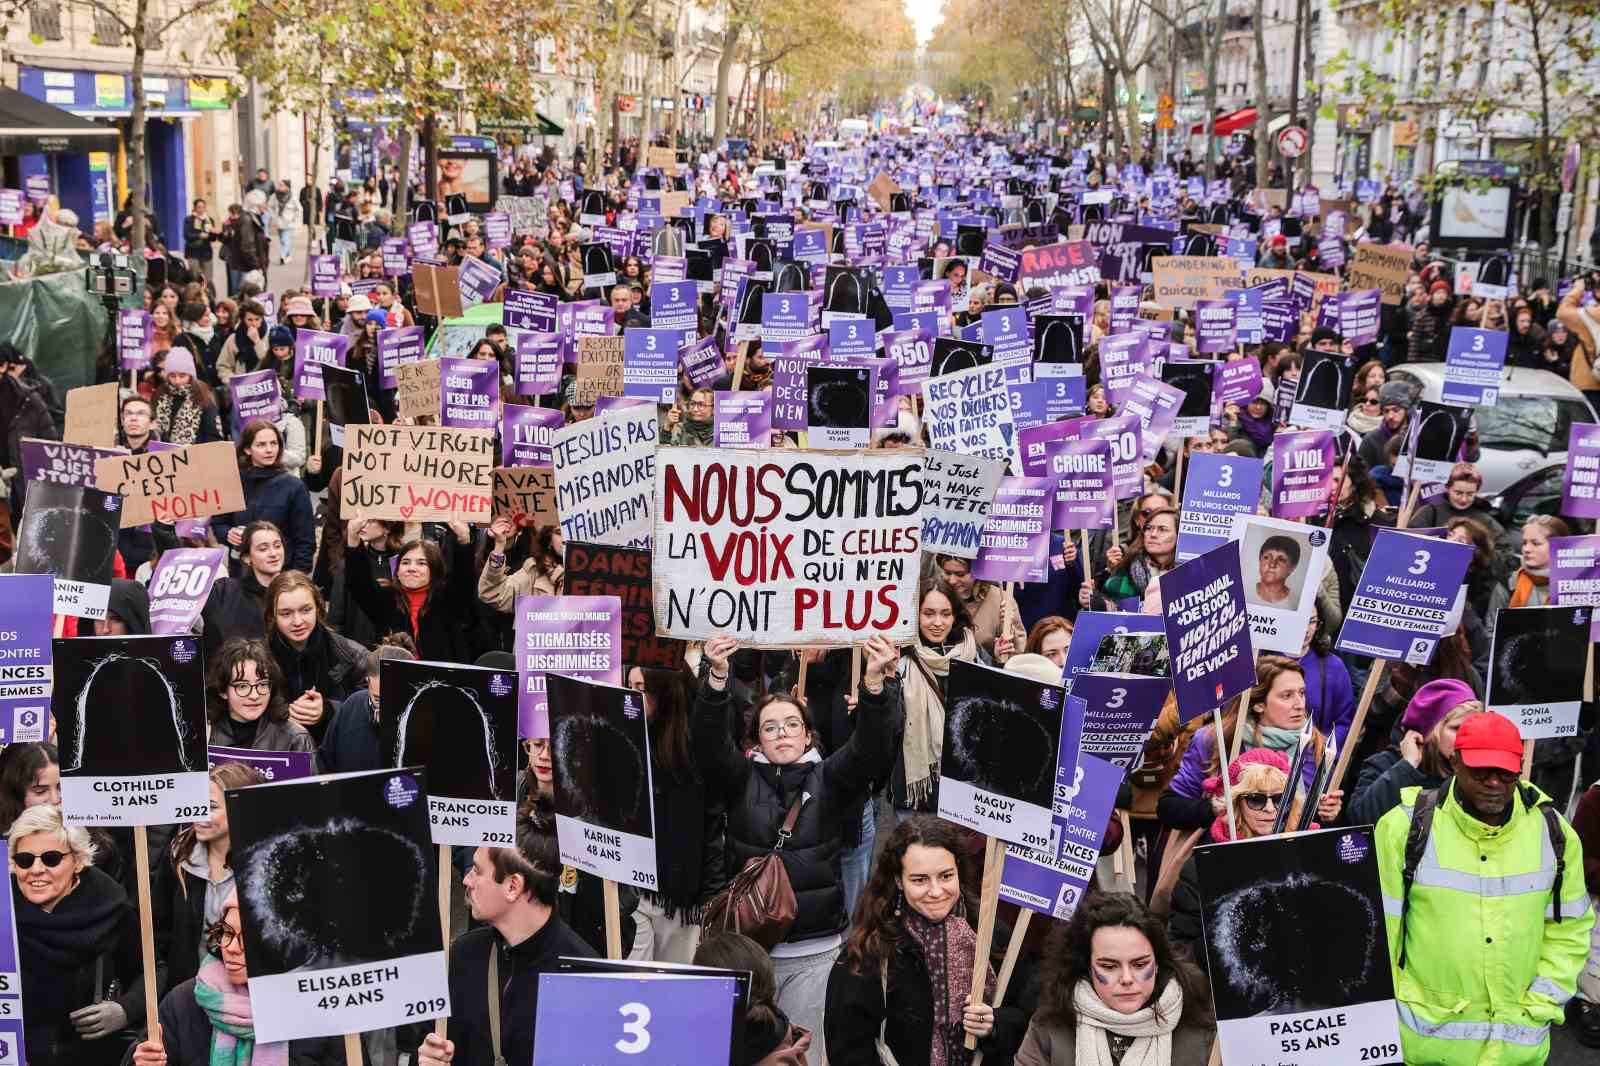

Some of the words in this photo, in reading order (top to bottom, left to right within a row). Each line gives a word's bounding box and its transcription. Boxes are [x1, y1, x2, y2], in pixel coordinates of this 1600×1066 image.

[806, 235, 813, 245] 3
[1086, 223, 1124, 244] NON
[1022, 242, 1085, 272] RAGE
[897, 271, 905, 282] 3
[670, 288, 679, 301] 3
[1239, 294, 1247, 306] 3
[780, 299, 790, 313] 3
[848, 325, 857, 339] 3
[1001, 316, 1010, 332] 3
[646, 336, 657, 351] 3
[1472, 335, 1485, 351] 3
[314, 346, 338, 363] VIOL
[582, 350, 624, 363] EXISTEN
[890, 341, 930, 366] 850
[446, 374, 472, 389] CÉDER
[929, 367, 1004, 402] RECYCLEZ
[1056, 383, 1066, 397] 3
[447, 391, 470, 405] N'EST
[471, 394, 490, 406] PAS
[777, 387, 791, 400] DE
[1011, 392, 1022, 410] 3
[775, 403, 804, 421] N'EN
[931, 402, 957, 421] VOS
[960, 413, 998, 433] FAITES
[358, 428, 402, 448] NOT
[409, 431, 495, 454] VIRGIN
[513, 425, 520, 442] 1
[962, 433, 987, 448] VOS
[123, 450, 189, 480] NON
[1053, 454, 1106, 474] CROIRE
[1283, 452, 1290, 469] 1
[1294, 449, 1326, 469] VIOL
[1574, 455, 1600, 469] MON
[36, 468, 79, 485] STOP
[348, 451, 391, 471] NOT
[403, 453, 490, 486] WHORE
[1217, 465, 1233, 487] 3
[1572, 469, 1598, 483] MON
[117, 474, 176, 498] C'EST
[1073, 479, 1103, 488] VICTIMES
[1308, 475, 1320, 484] les
[344, 475, 400, 507] JUST
[407, 481, 493, 513] WOMEN
[664, 462, 786, 527] NOUS
[785, 462, 923, 522] SOMMES
[946, 482, 984, 497] HAVE
[1203, 490, 1241, 500] MILLIARDS
[1280, 490, 1288, 504] 6
[1570, 484, 1595, 498] MES
[151, 489, 222, 521] NON!
[992, 503, 1044, 517] IGMATISÉES
[1189, 500, 1222, 510] D'EUROS
[1223, 503, 1252, 513] CONTRE
[1184, 511, 1204, 522] LES
[1182, 525, 1206, 535] FAITES
[981, 535, 1028, 549] ATTAQUÉES
[668, 532, 697, 559] LA
[700, 526, 796, 586] VOIX
[803, 529, 835, 556] DE
[842, 526, 919, 555] CELLES
[1407, 550, 1431, 575] 3
[856, 558, 903, 581] N'EN
[155, 565, 211, 597] 850
[1385, 575, 1437, 590] MILLIARDS
[57, 595, 79, 604] ANS
[1168, 597, 1186, 617] AU
[1185, 574, 1234, 608] TRAVAIL
[1366, 585, 1408, 600] D'EUROS
[1409, 592, 1449, 605] CONTRE
[84, 607, 105, 616] 2017
[667, 588, 776, 631] N'ONT
[794, 584, 908, 631] PLUS.
[1356, 595, 1377, 609] LES
[1380, 600, 1447, 621] VIOLENCES
[1180, 612, 1218, 651] VIOLS
[1220, 598, 1236, 626] OU
[1254, 625, 1277, 635] ANS
[1351, 611, 1382, 623] FAITES
[1384, 617, 1402, 627] AUX
[1403, 621, 1441, 633] FEMMES
[527, 630, 611, 648] STIGMATISÉES
[1175, 609, 1246, 674] TENTATIVES
[527, 651, 610, 670] DISCRIMINÉES
[1186, 663, 1205, 682] DE
[1205, 644, 1239, 673] VIOLS
[1105, 687, 1128, 709] 3
[1521, 708, 1550, 716] SONIA
[1535, 716, 1552, 725] ANS
[1107, 722, 1144, 730] CONTRE
[1554, 725, 1576, 734] 2018
[93, 779, 175, 792] CLOTHILDE
[111, 796, 124, 806] 31
[127, 795, 158, 806] ANS
[430, 801, 508, 815] FRANCOISE
[974, 793, 1015, 812] MAGUY
[175, 806, 209, 818] 2022
[974, 805, 986, 817] 52
[988, 811, 1012, 824] ANS
[442, 817, 469, 827] ANS
[482, 832, 513, 843] 2022
[584, 828, 621, 847] KARINE
[1021, 832, 1048, 846] 2019
[586, 844, 598, 855] 48
[600, 849, 621, 862] ANS
[1035, 852, 1054, 866] AUX
[1054, 859, 1088, 877] FEMMES
[632, 870, 656, 884] 2019
[298, 967, 399, 993] ELISABETH
[317, 995, 339, 1009] 49
[345, 989, 384, 1007] ANS
[405, 998, 446, 1016] 2019
[615, 1002, 651, 1054] 3
[1270, 1014, 1347, 1035] PASCALE
[1281, 1039, 1300, 1052] 55
[1305, 1033, 1340, 1051] ANS
[1360, 1043, 1398, 1061] 2019
